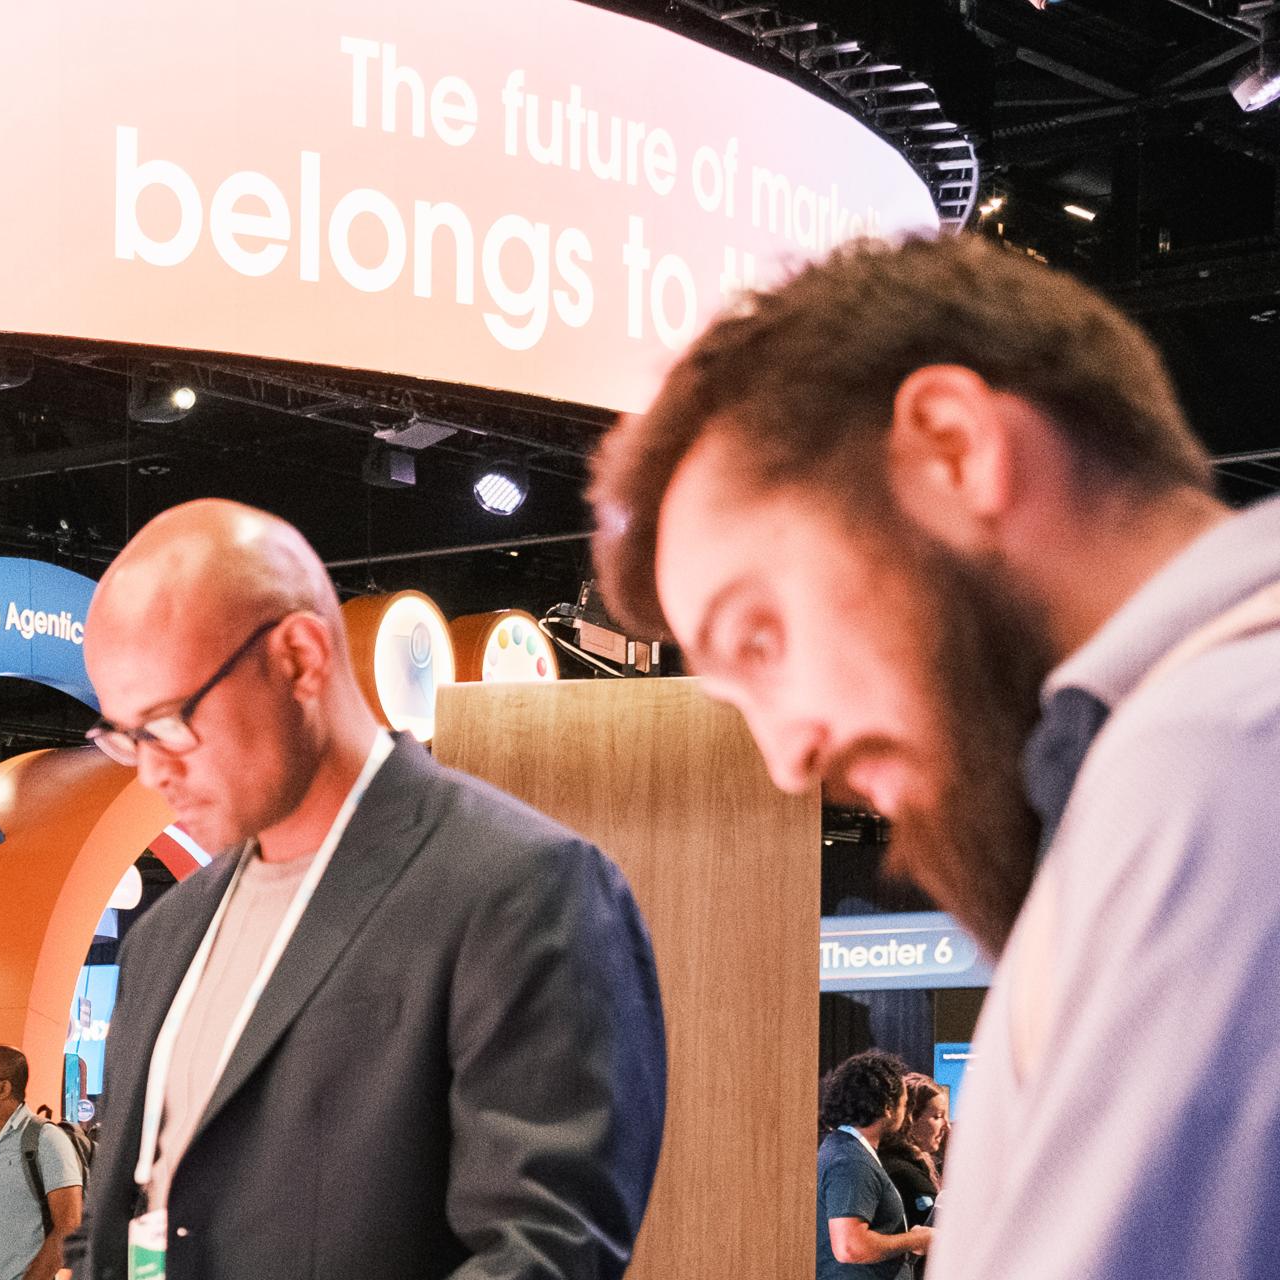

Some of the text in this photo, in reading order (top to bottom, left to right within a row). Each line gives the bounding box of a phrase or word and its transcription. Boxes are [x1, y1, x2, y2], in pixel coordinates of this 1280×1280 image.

[341, 35, 478, 146] The
[501, 70, 677, 197] future
[692, 134, 739, 218] of
[115, 125, 697, 350] belongs to
[5, 601, 84, 645] Agentic
[820, 937, 953, 969] Theater 6
